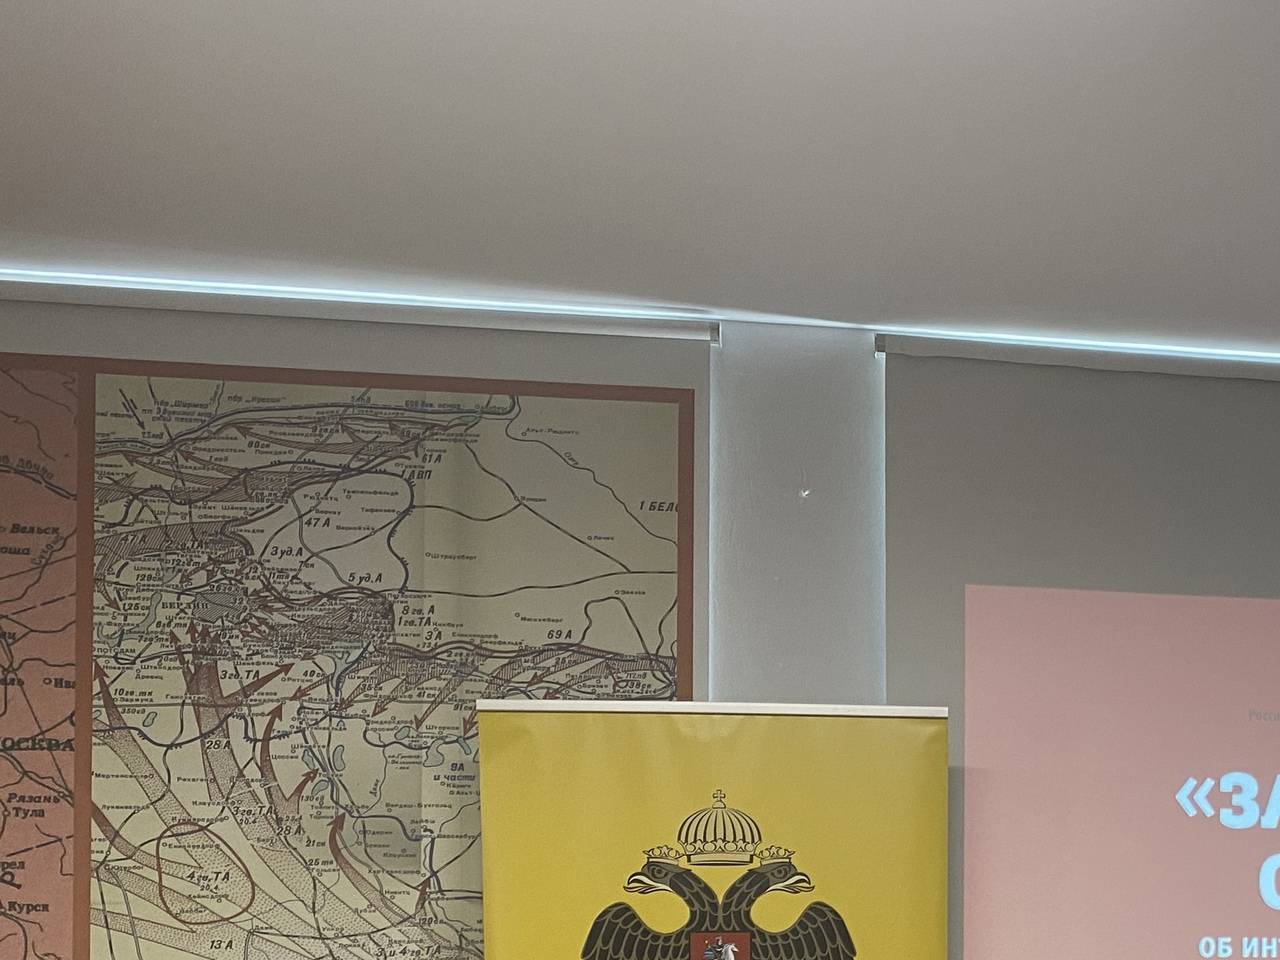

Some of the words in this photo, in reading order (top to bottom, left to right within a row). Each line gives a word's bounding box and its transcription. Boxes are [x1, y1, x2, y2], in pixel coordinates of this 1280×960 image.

[305, 518, 320, 528] 47
[322, 518, 330, 528] А
[10, 524, 60, 535] Вельск
[547, 630, 562, 640] 69
[0, 737, 75, 751] ОСКВА
[206, 740, 219, 750] 28
[6, 792, 61, 804] Рязань
[13, 807, 46, 819] Тула
[8, 901, 50, 913] Курск
[210, 939, 222, 950] 13
[1199, 936, 1232, 960] ОБ
